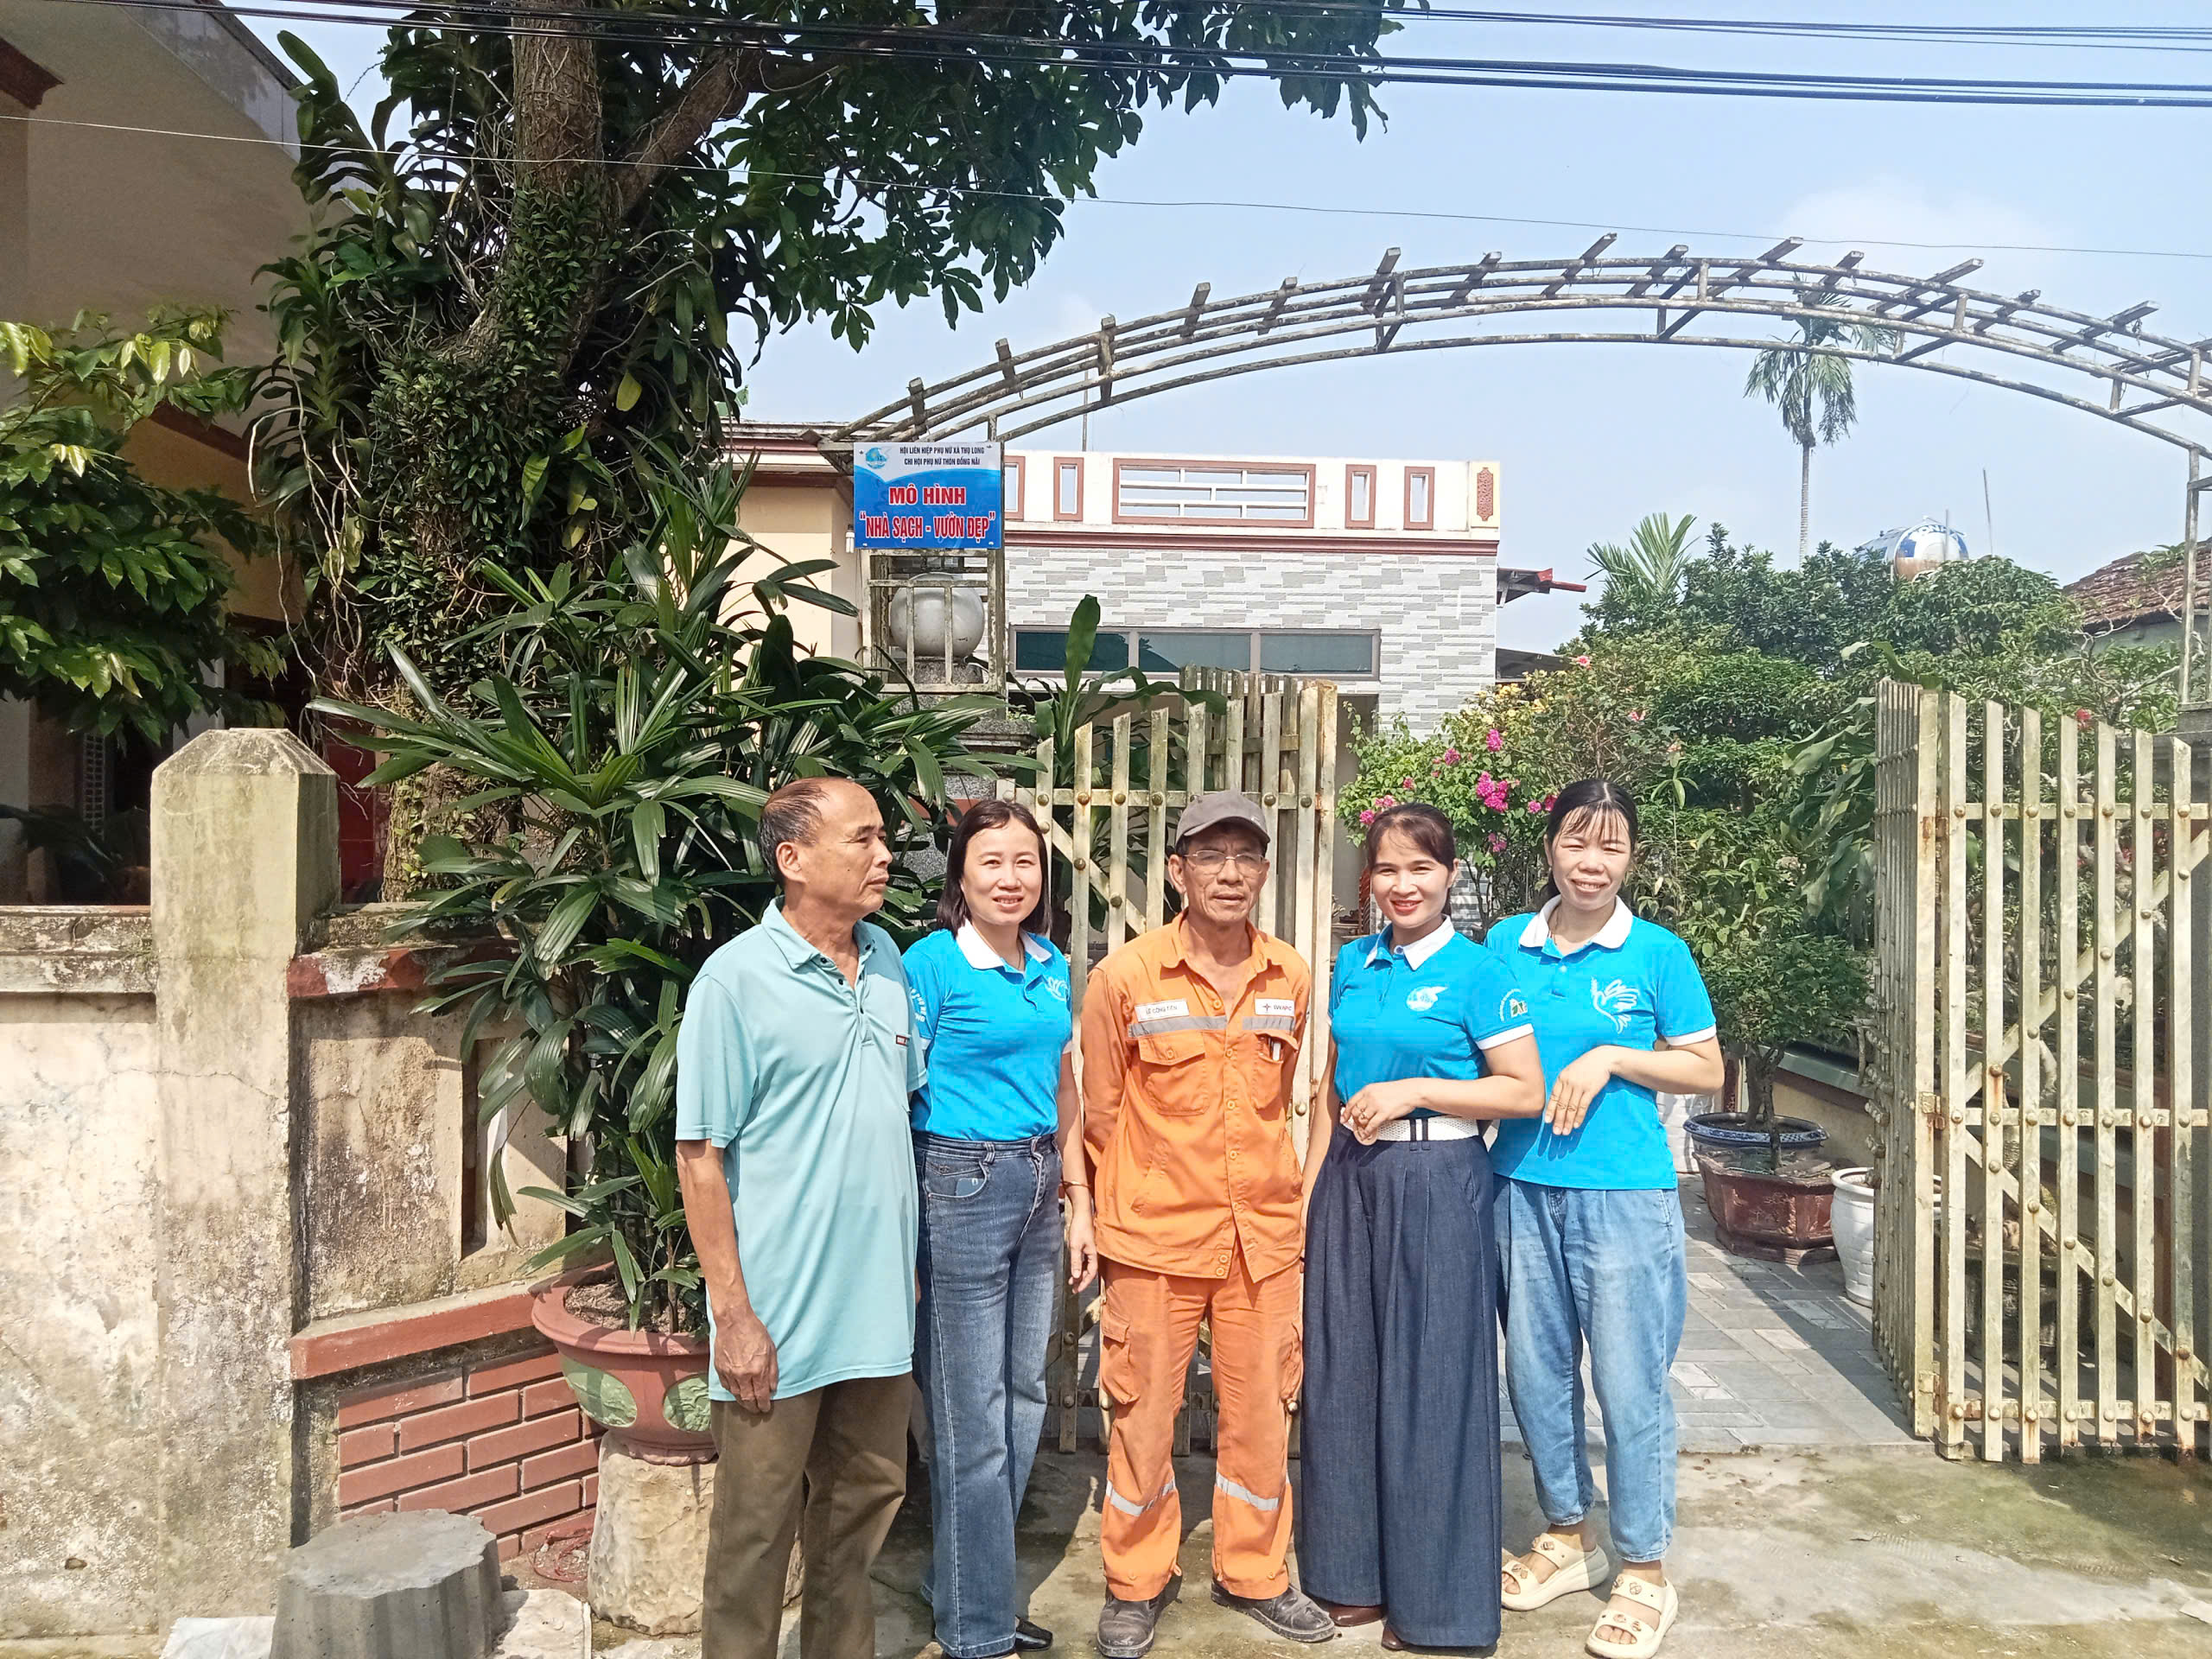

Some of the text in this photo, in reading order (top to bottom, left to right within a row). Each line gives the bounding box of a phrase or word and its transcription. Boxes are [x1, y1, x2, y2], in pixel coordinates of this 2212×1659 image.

[899, 446, 908, 455] HỘI
[909, 446, 920, 454] LIÊN
[921, 446, 932, 455] HIỆP
[933, 447, 944, 455] PHỤ
[944, 446, 952, 454] NỮ
[961, 447, 970, 455] THỌ
[913, 457, 923, 467] HỘI
[923, 458, 933, 467] PHỤ
[934, 457, 942, 466] NỮ
[943, 457, 956, 466] THÔN
[889, 483, 966, 505] MÔ HÌNH
[893, 517, 923, 543] SẠCH
[934, 512, 965, 538] VƯỜN
